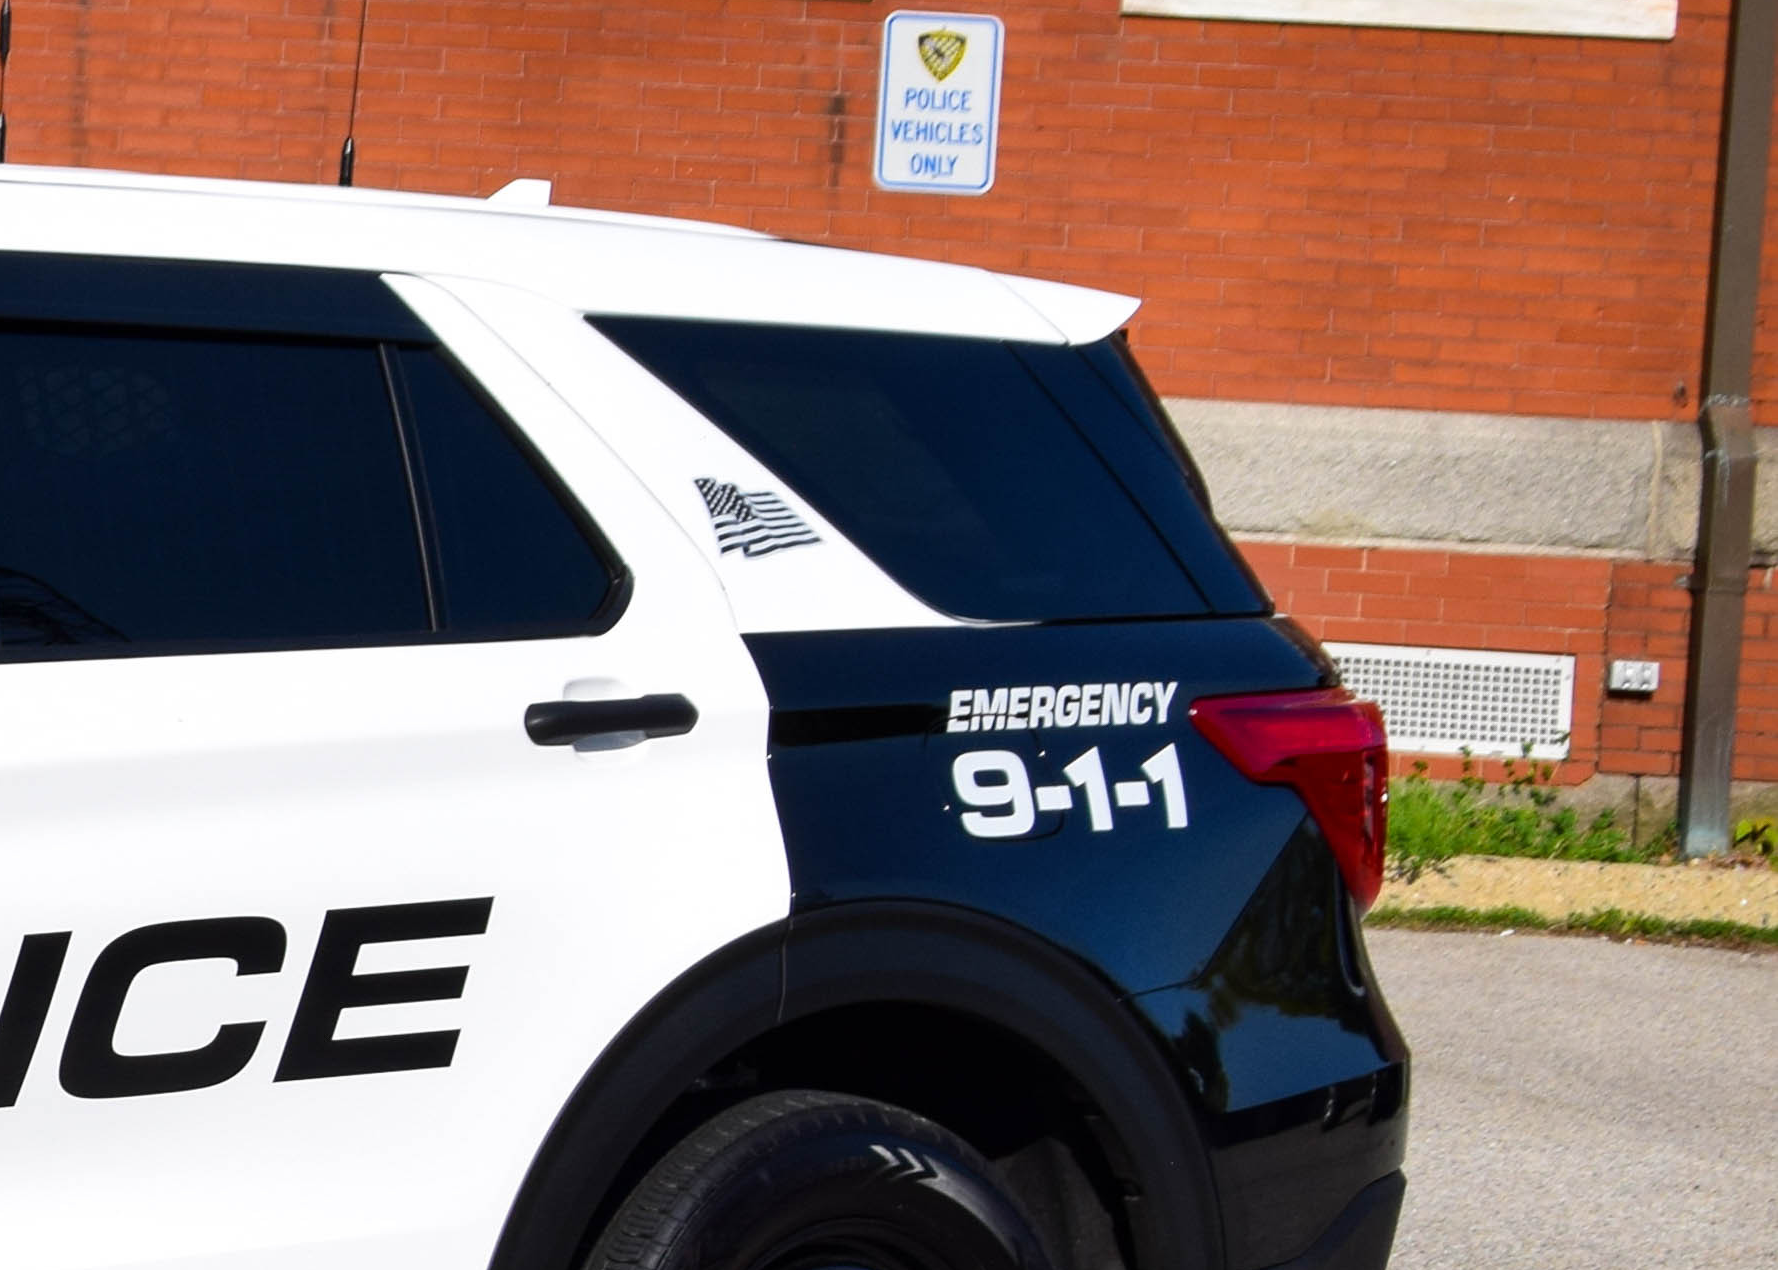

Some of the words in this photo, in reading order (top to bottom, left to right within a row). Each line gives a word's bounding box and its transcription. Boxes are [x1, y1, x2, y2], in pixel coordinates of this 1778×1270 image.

[905, 88, 972, 112] POLICE
[891, 120, 984, 146] VEHICLES
[909, 153, 958, 176] ONLY
[946, 681, 1179, 733] EMERGENCY
[952, 742, 1189, 839] 9-1-1
